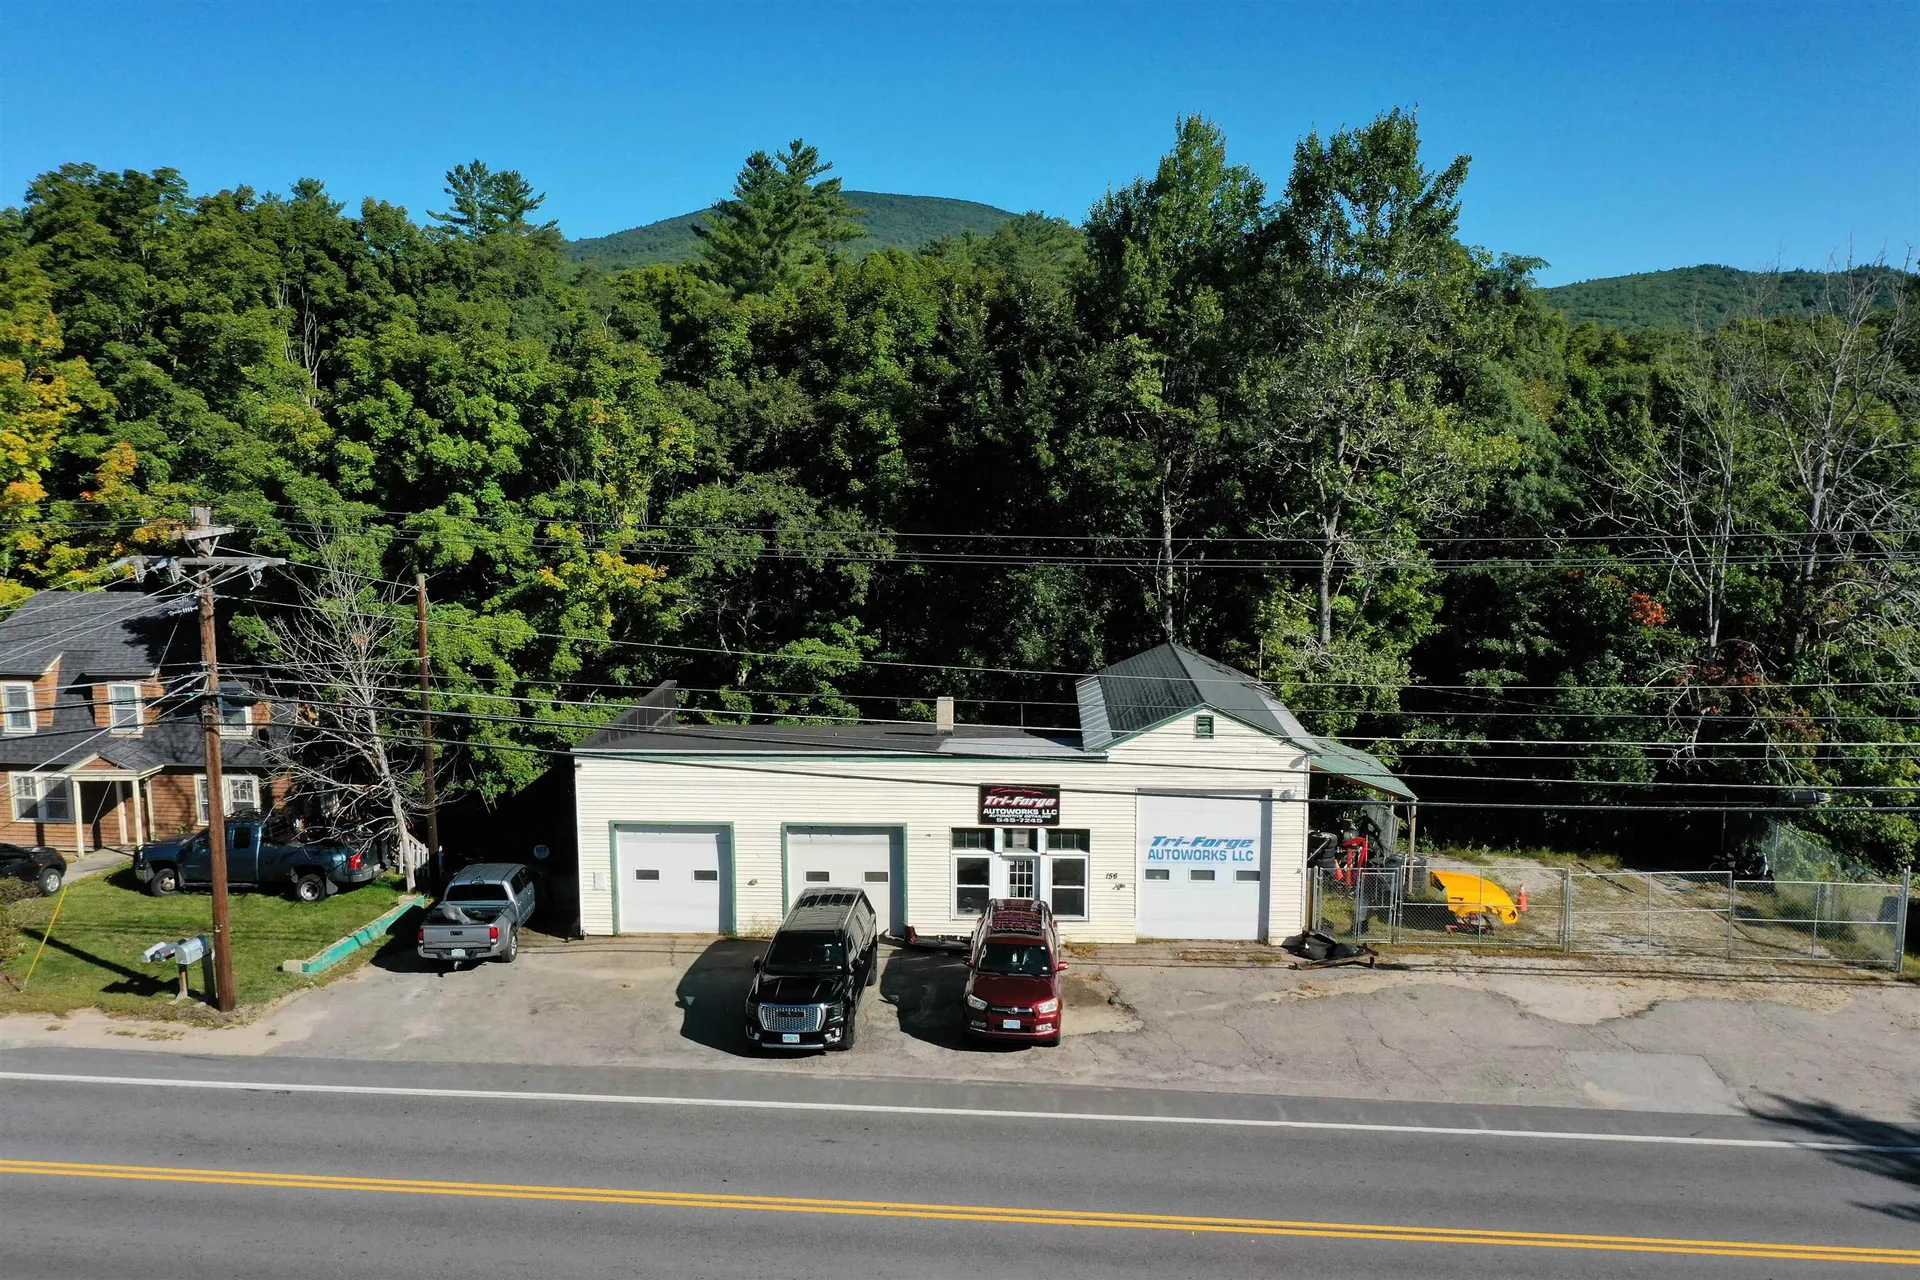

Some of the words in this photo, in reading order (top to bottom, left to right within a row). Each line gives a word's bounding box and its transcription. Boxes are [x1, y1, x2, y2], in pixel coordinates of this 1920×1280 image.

[984, 796, 1057, 807] Tri-Forge
[1151, 836, 1255, 849] Tri-Forge
[1147, 849, 1227, 861] AUTOWORKS
[1232, 850, 1254, 861] LLC
